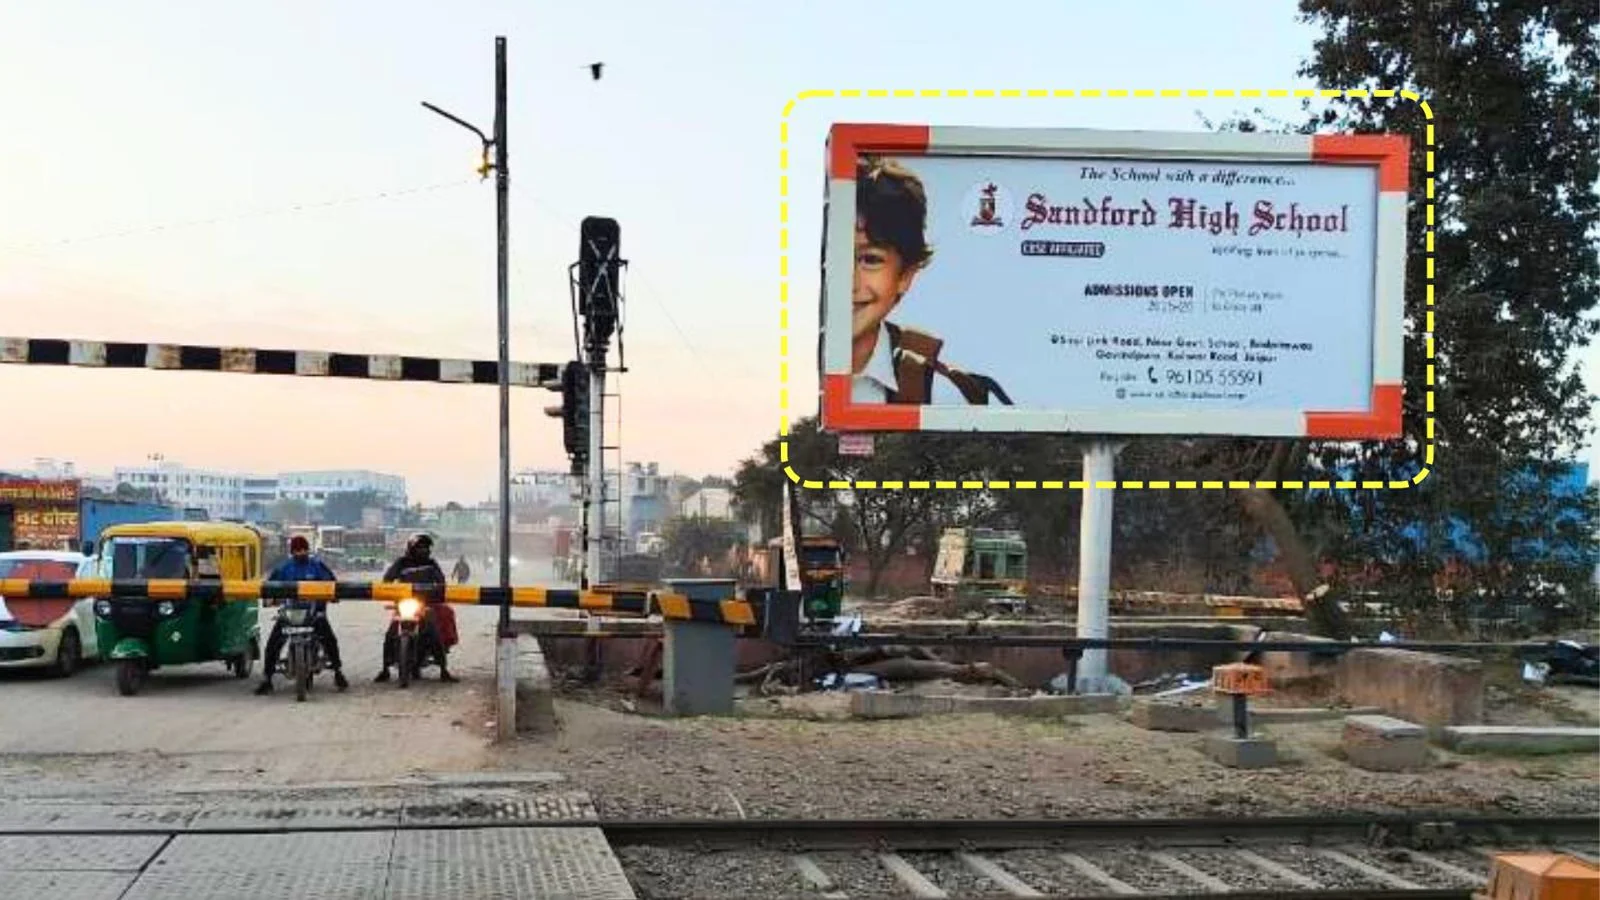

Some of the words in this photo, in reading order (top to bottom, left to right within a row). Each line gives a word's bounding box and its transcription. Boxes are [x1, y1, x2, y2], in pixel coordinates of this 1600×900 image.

[1080, 166, 1104, 180] The
[1111, 167, 1160, 182] School
[1166, 169, 1195, 183] with
[1200, 173, 1207, 181] a
[1021, 193, 1157, 230] Sandford
[1168, 197, 1240, 236] High
[1248, 199, 1348, 238] School
[1084, 283, 1158, 298] ADMISSIONS
[1162, 285, 1194, 299] OPEN
[1166, 369, 1213, 384] 96105
[1218, 370, 1263, 386] 55591
